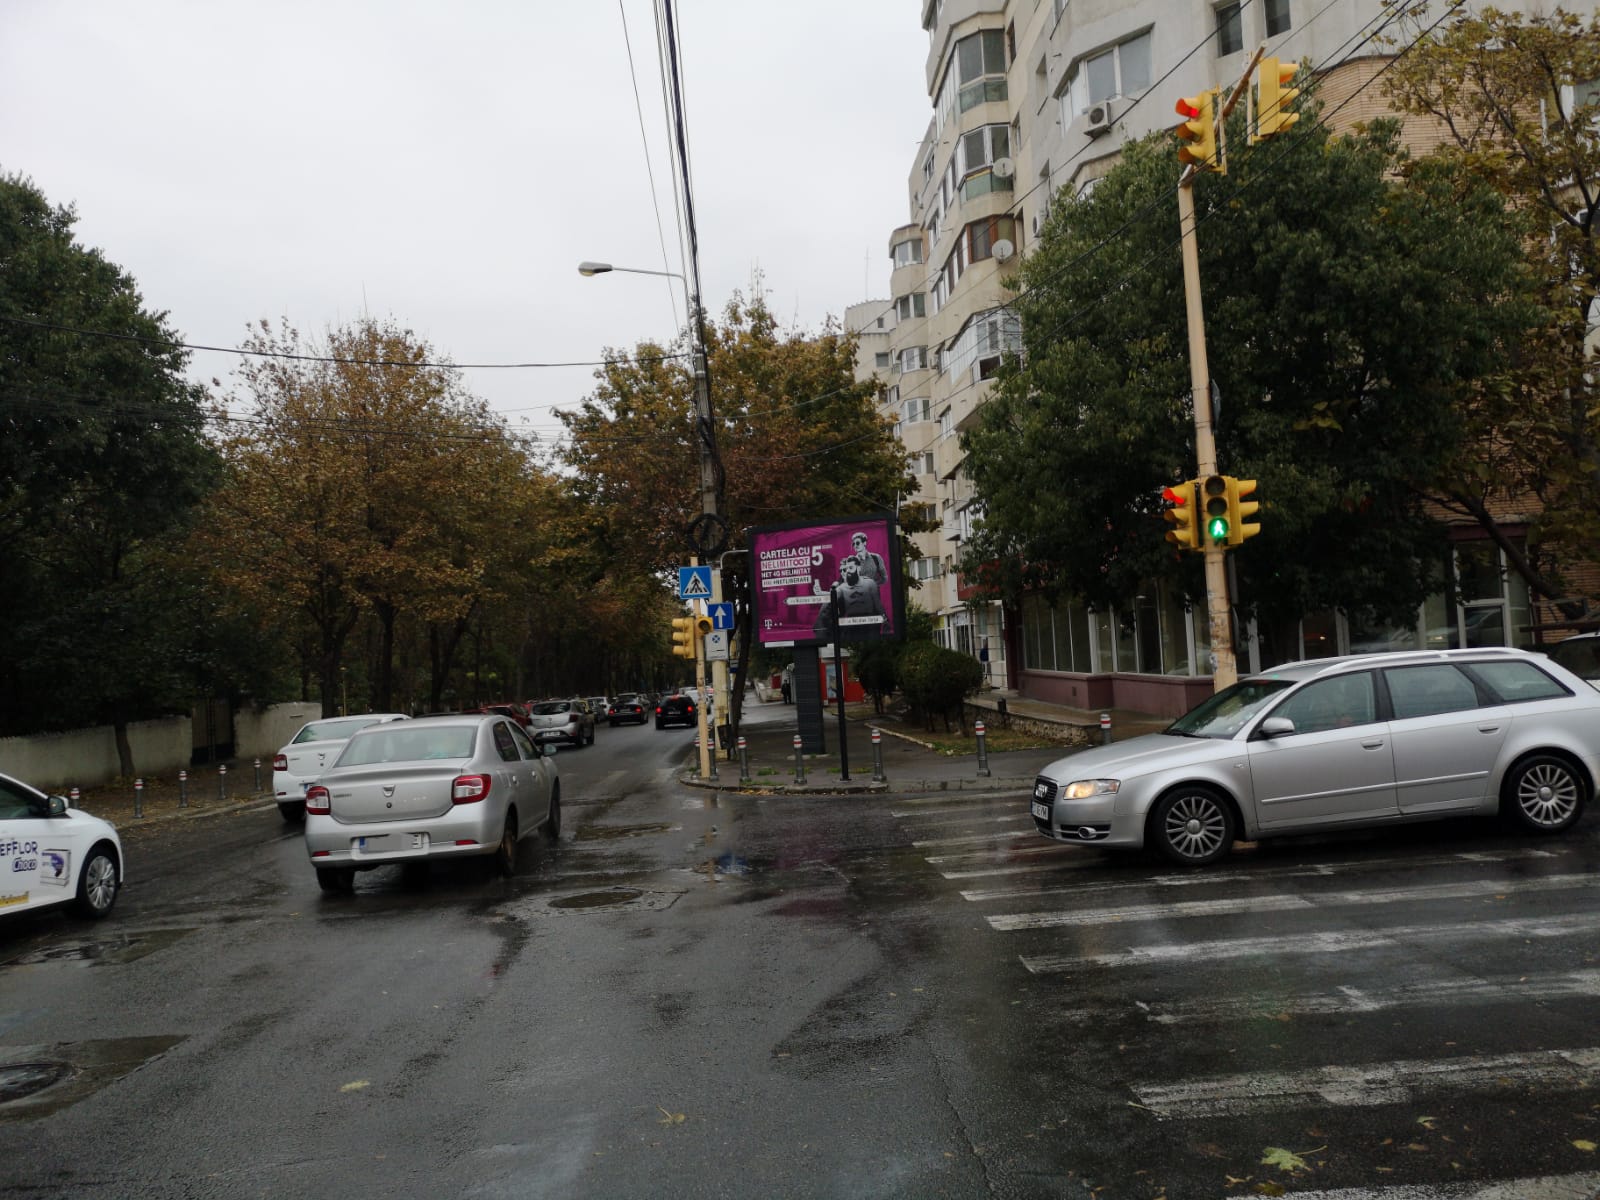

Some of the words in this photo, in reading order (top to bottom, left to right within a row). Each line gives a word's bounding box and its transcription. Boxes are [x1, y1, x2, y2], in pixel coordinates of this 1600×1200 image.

[760, 548, 797, 560] CARTELA
[798, 546, 810, 556] CU
[811, 545, 824, 566] 5
[781, 567, 811, 577] NELIMITAT
